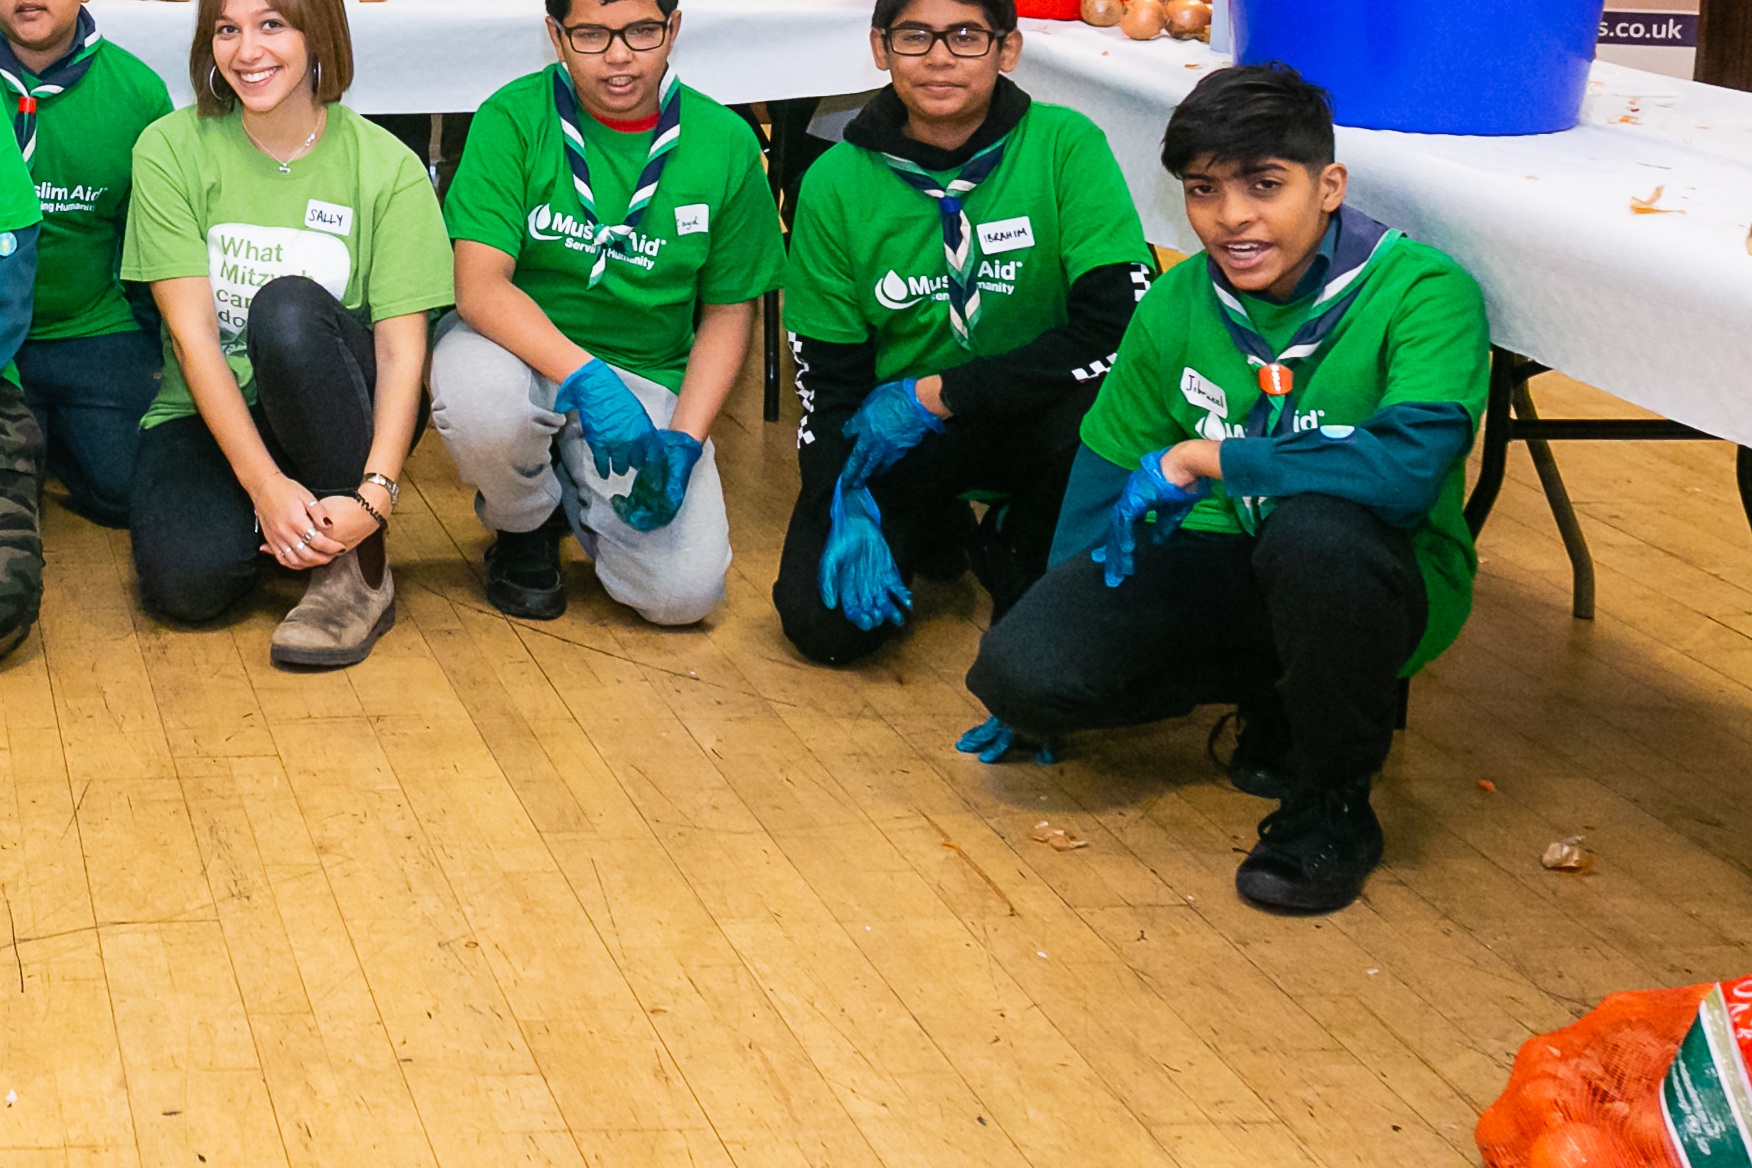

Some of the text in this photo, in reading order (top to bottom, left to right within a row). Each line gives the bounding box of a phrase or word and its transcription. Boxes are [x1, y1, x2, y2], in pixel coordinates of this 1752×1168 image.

[1598, 18, 1683, 40] s.co.uk
[40, 201, 54, 213] ing
[308, 208, 344, 227] SALLY
[551, 211, 595, 241] Mus
[677, 215, 699, 230] ayd
[220, 234, 283, 262] What
[908, 259, 1016, 296] Mus Aid
[218, 309, 246, 328] do
[1292, 409, 1319, 433] id
